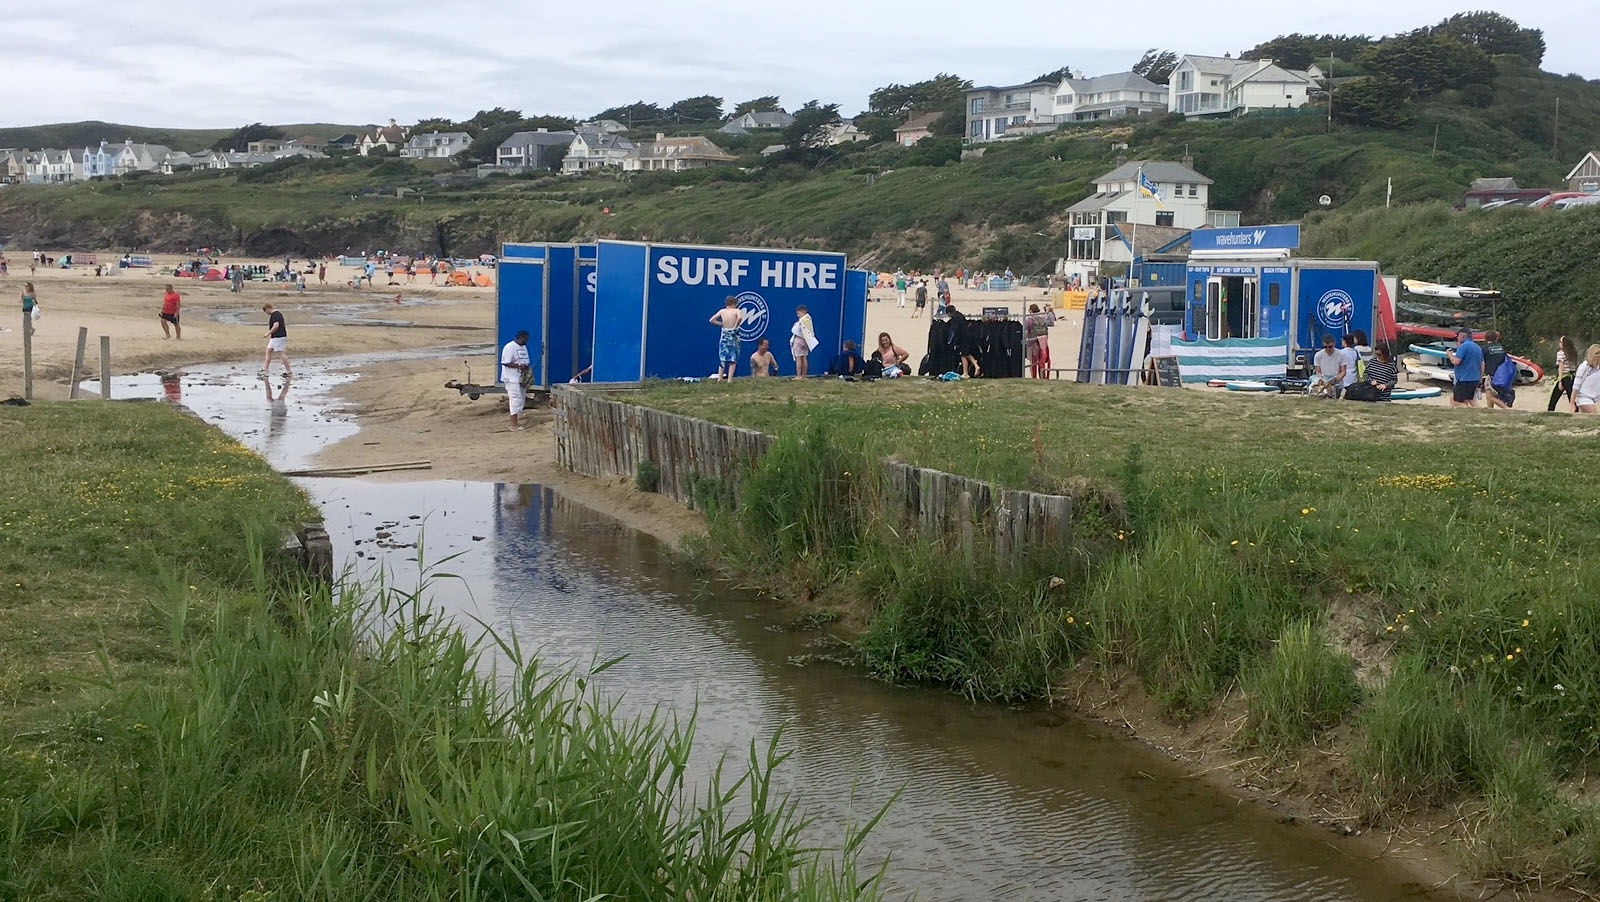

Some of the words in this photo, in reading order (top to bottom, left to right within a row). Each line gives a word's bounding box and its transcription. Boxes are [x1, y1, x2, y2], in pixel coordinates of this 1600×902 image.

[1215, 231, 1252, 246] wavehunters
[656, 255, 750, 287] SURF
[760, 260, 838, 290] HIRE
